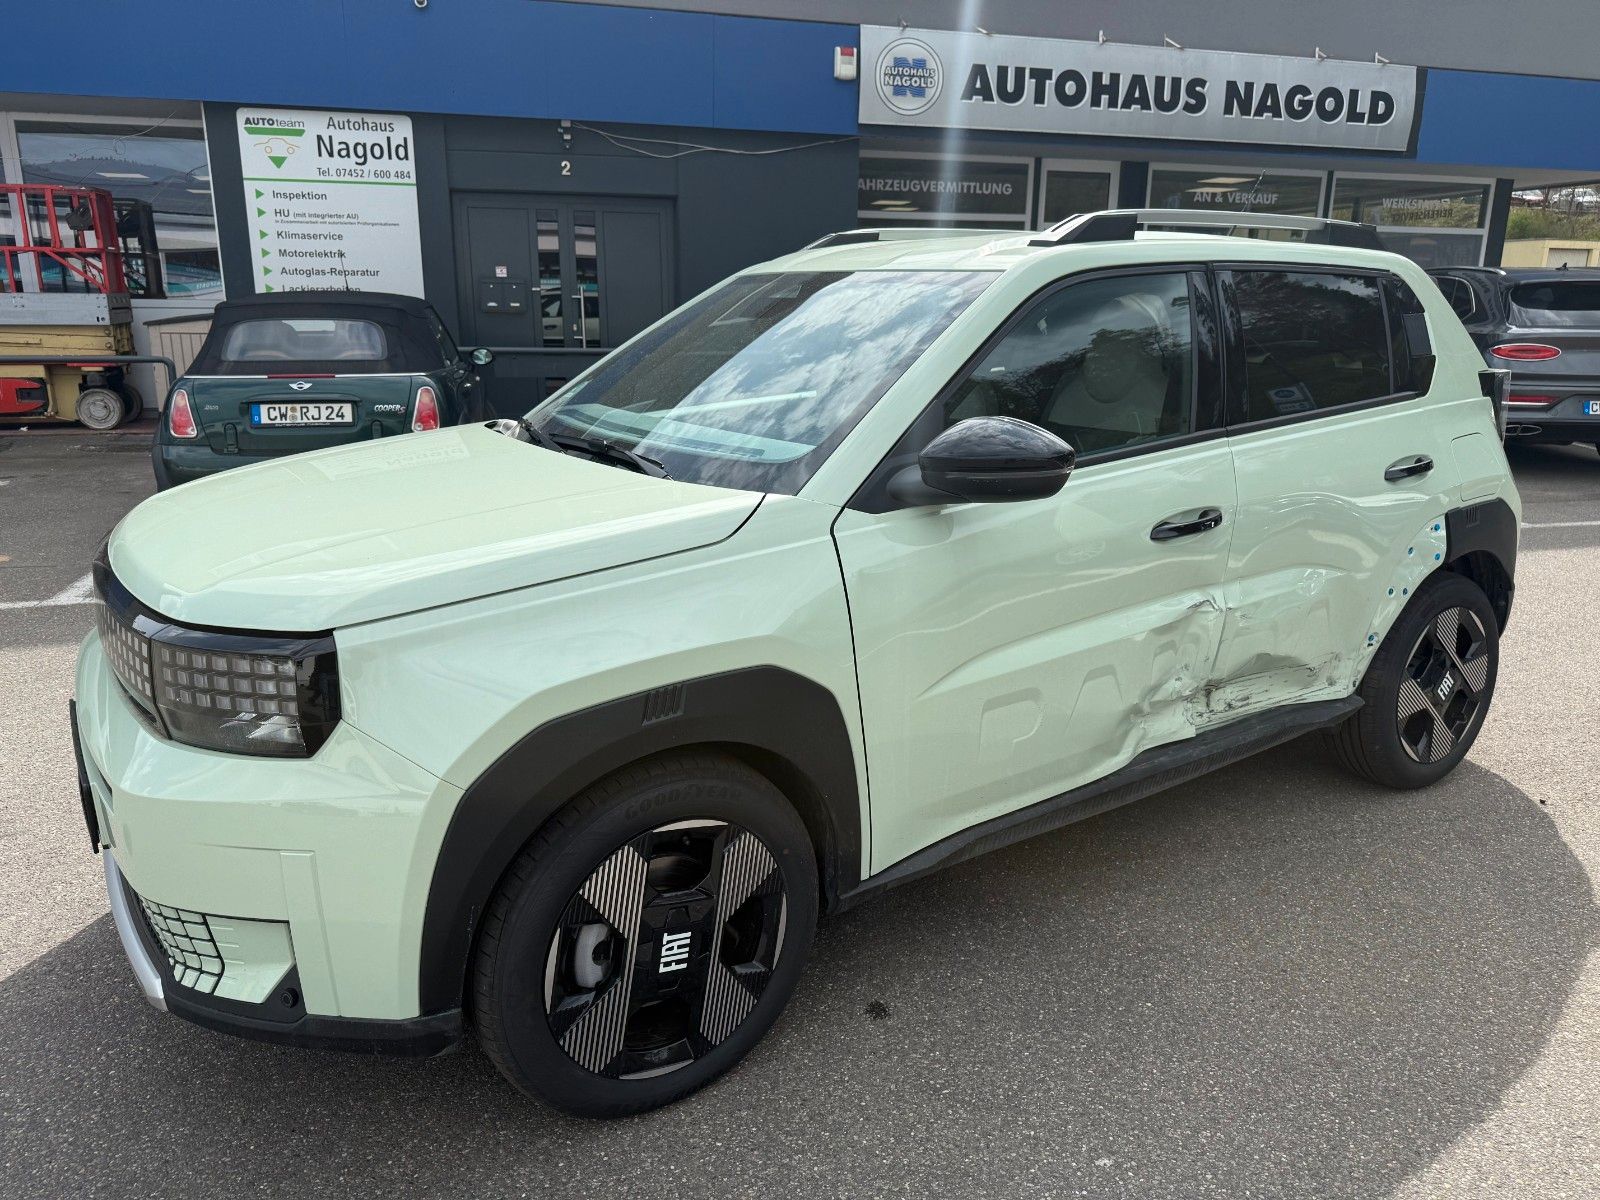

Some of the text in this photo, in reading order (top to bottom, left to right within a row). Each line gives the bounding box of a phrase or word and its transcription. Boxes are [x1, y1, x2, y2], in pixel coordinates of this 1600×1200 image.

[884, 66, 936, 78] AUTOHAUS
[884, 75, 936, 88] NAGOLD
[960, 63, 1395, 126] AUTOHAUS NAGOLD
[244, 116, 304, 128] AUTOteam
[326, 116, 394, 132] Autohaus
[316, 134, 410, 166] Nagold
[316, 168, 333, 176] Tel.
[336, 168, 364, 178] 07452
[374, 170, 391, 179] 600
[394, 170, 411, 180] 484
[560, 161, 571, 176] 2
[858, 178, 1013, 195] AHRZEUGVERMITTLUNG
[272, 190, 328, 201] Inspektion
[1194, 191, 1280, 205] AN & VERKAUF
[274, 208, 290, 218] HU
[276, 230, 344, 241] Klimaservice
[278, 248, 346, 258] Motorelektrik
[280, 267, 380, 278] Autoglas-Reparatur
[1591, 402, 1600, 412] C
[267, 406, 345, 422] CW RJ 24
[1438, 670, 1454, 700] FIAT
[658, 932, 692, 974] FIAT
